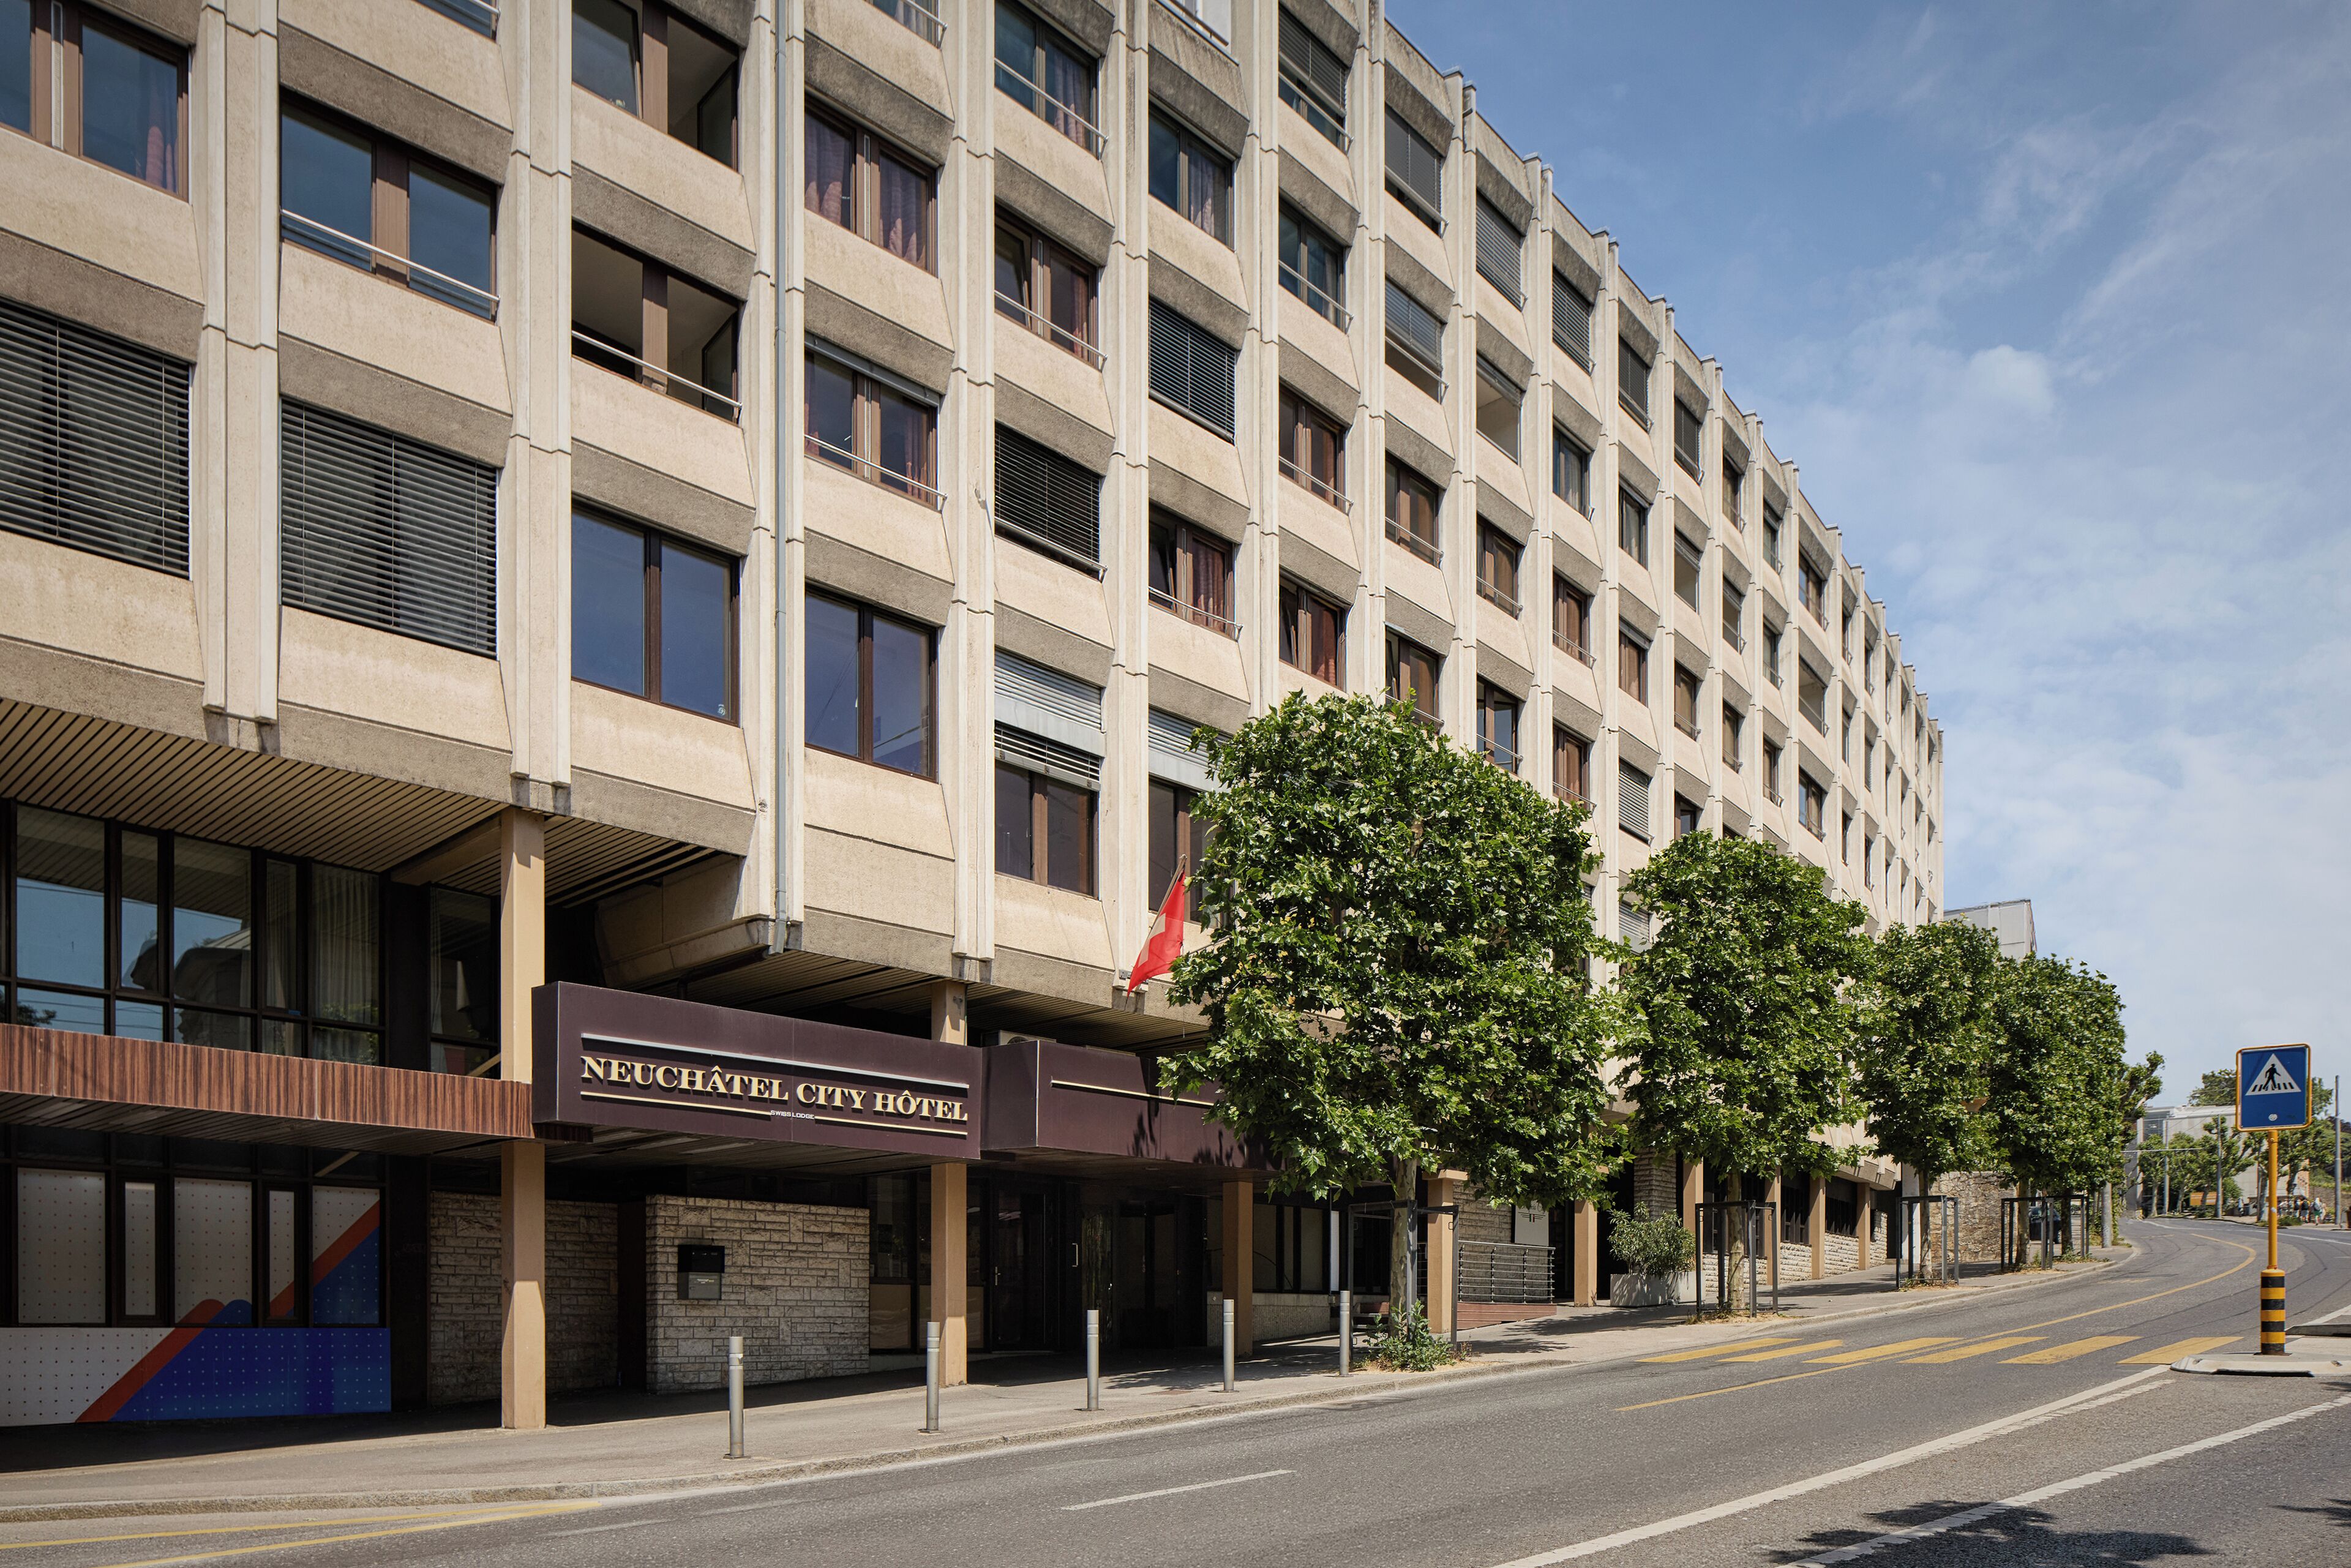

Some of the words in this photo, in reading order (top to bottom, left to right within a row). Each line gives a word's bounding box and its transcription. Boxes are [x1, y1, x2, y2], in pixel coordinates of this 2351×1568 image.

[580, 1056, 789, 1100] NEUCHÂTEL
[797, 1083, 866, 1109] CITY
[873, 1090, 967, 1120] HÔTEL
